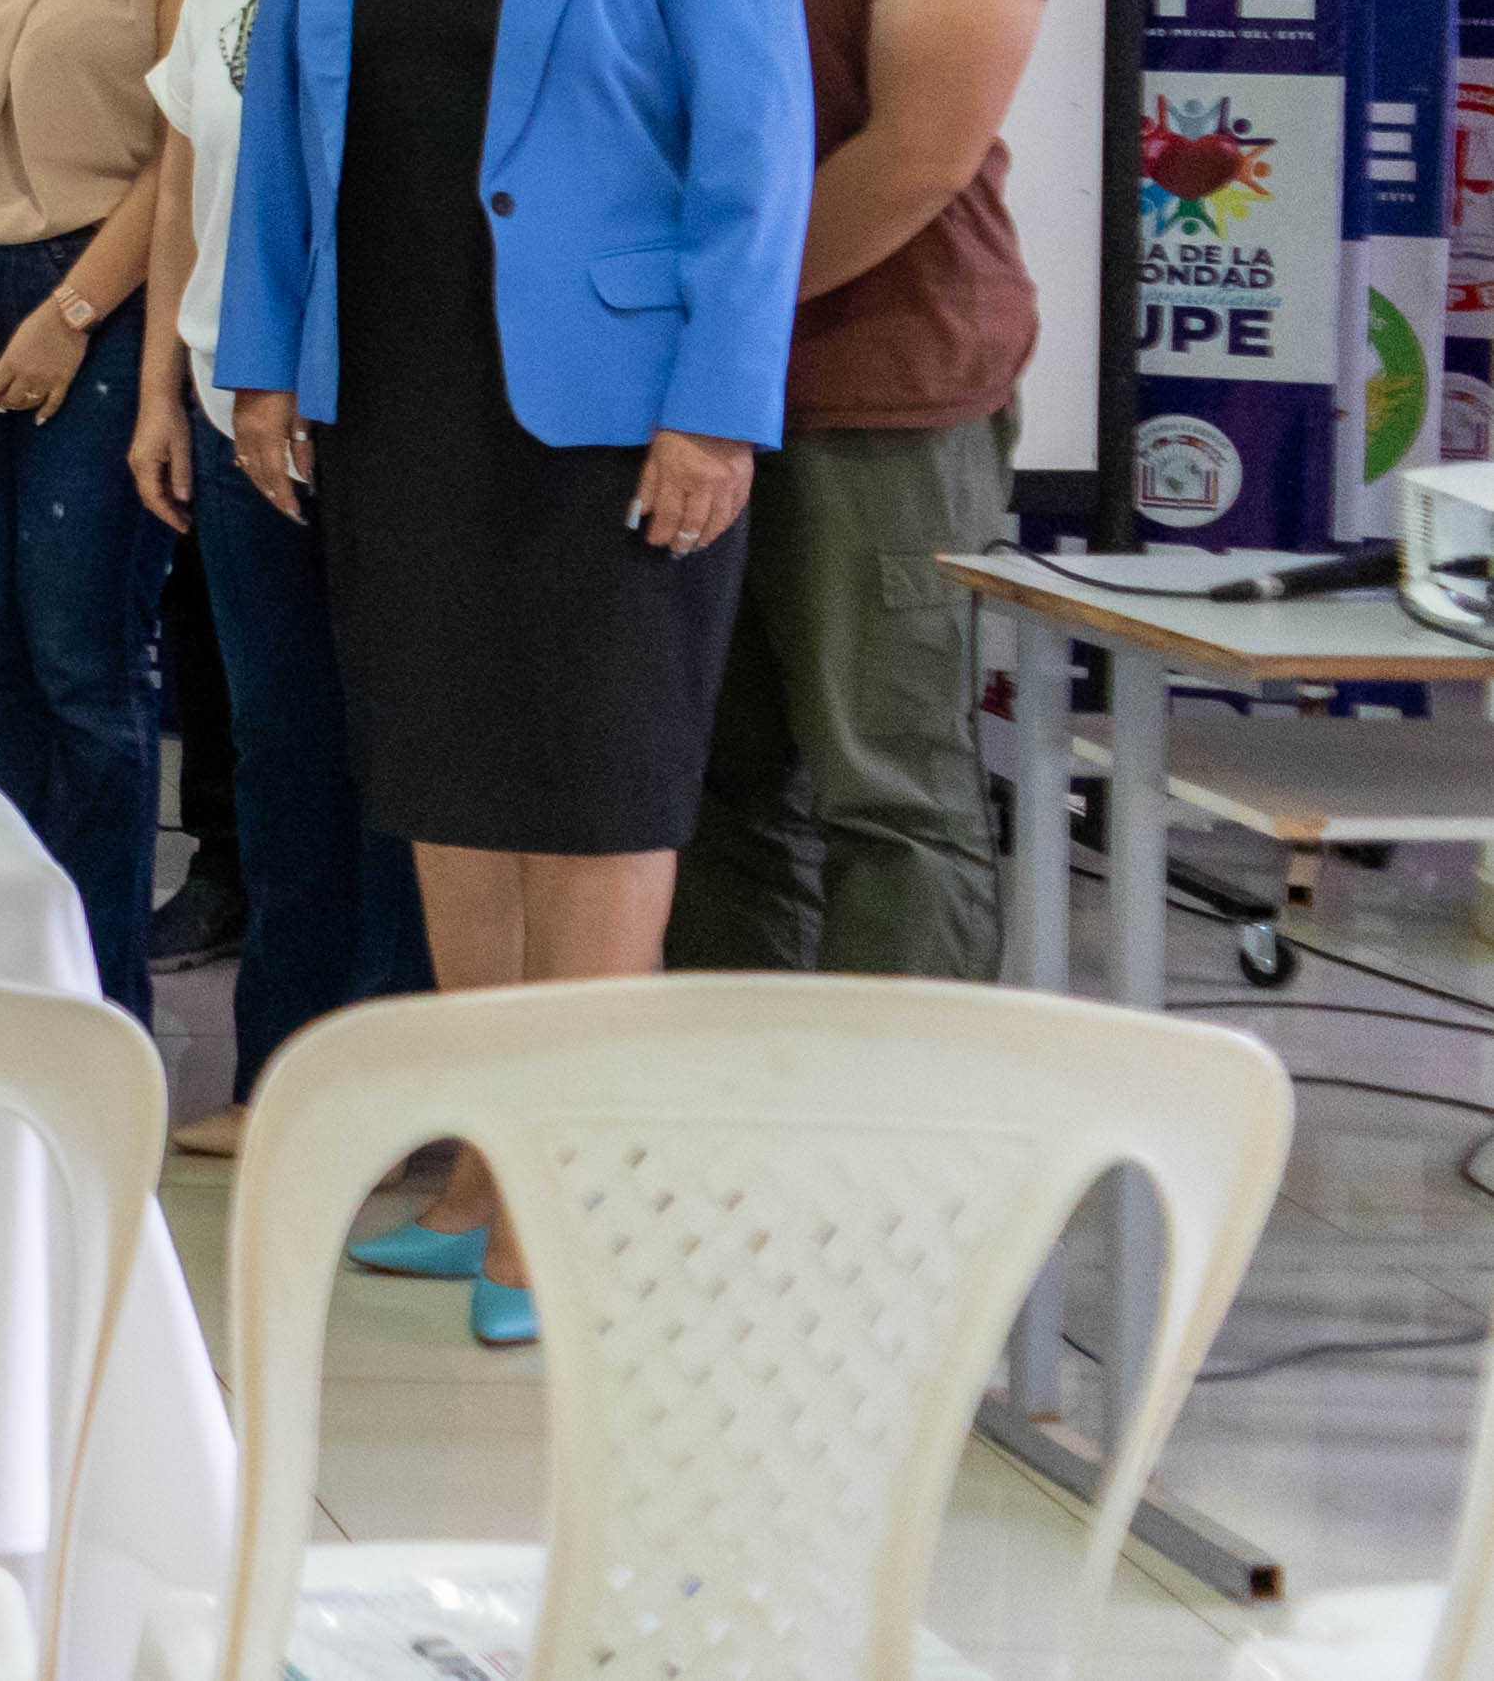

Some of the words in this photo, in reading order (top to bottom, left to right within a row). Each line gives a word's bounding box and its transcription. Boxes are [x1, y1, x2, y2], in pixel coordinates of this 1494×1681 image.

[1179, 244, 1222, 265] DE
[1232, 246, 1274, 268] LA
[1139, 263, 1275, 290] ONDAD
